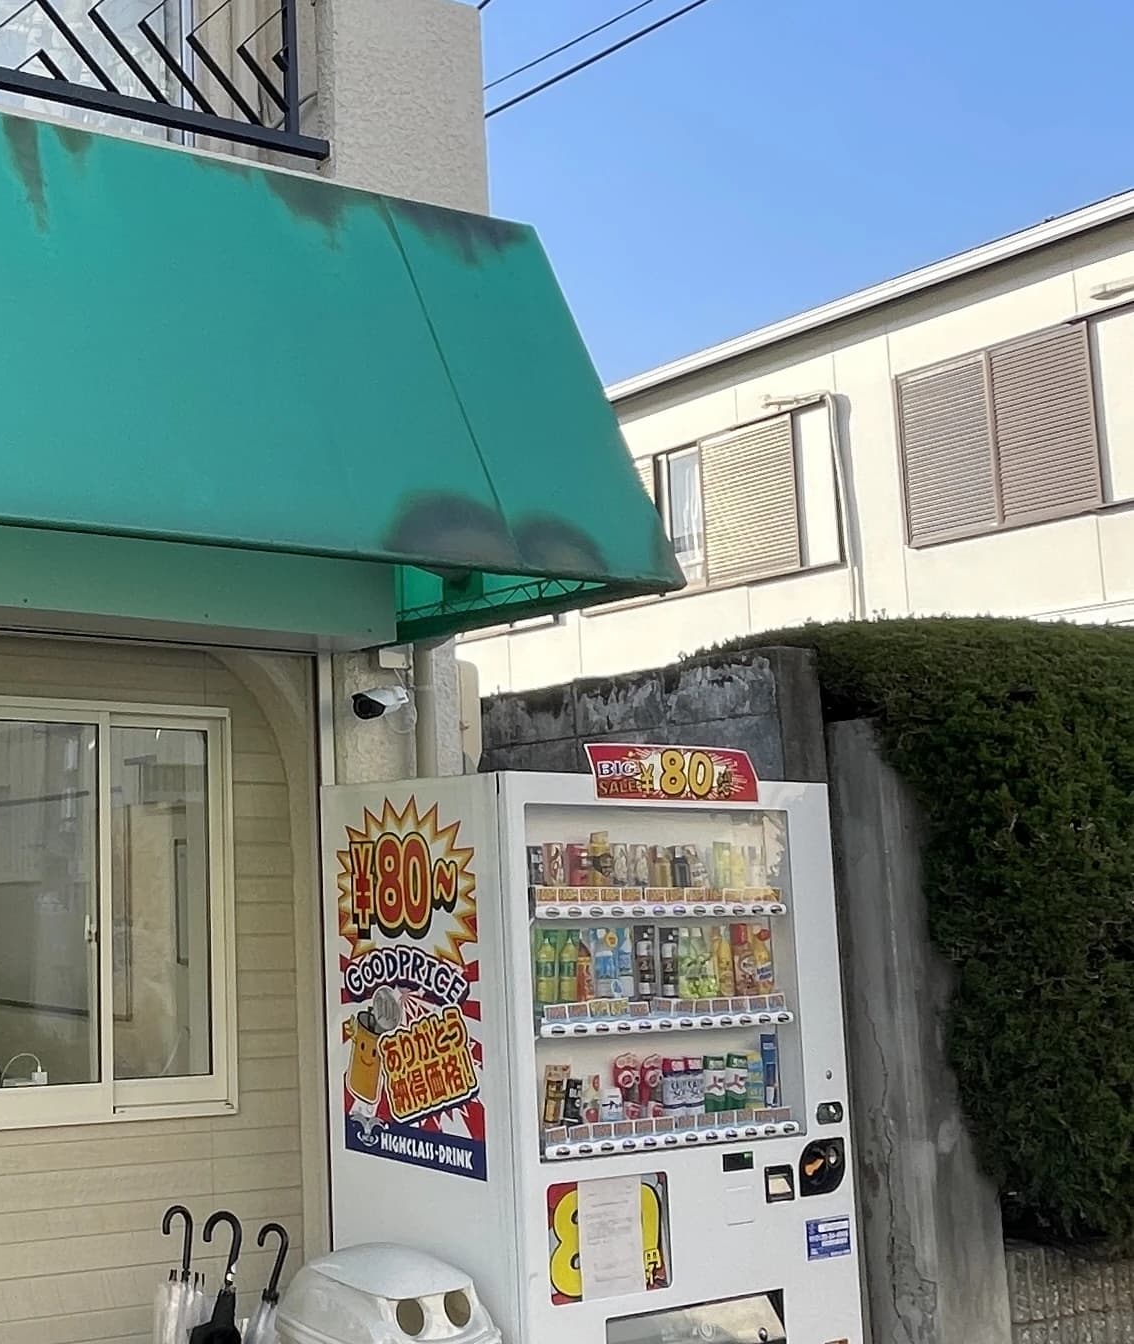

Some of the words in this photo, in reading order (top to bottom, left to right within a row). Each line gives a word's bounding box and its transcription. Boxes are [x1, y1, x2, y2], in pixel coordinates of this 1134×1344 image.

[597, 761, 636, 778] BIG
[598, 778, 637, 795] SALE
[382, 1012, 466, 1074] ありがとう
